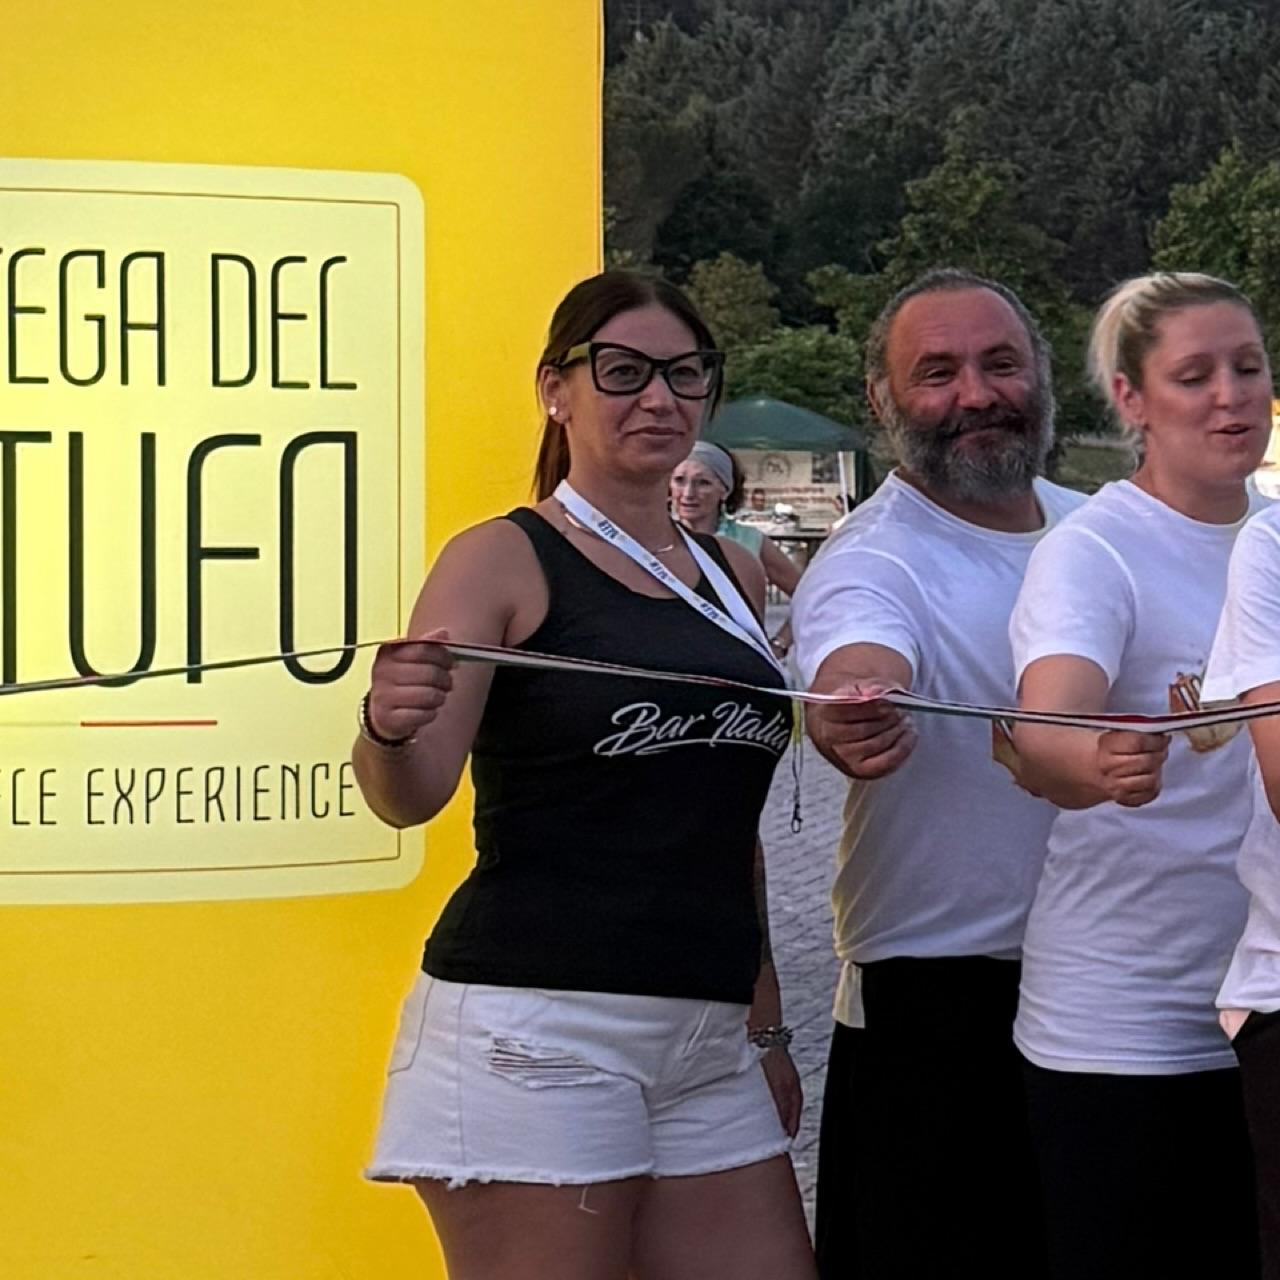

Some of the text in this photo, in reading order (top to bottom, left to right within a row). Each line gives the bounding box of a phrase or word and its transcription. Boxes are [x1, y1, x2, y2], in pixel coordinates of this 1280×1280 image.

[0, 248, 358, 390] EGA DEL
[593, 702, 705, 757] Bar
[86, 762, 355, 826] EXPERIENCE
